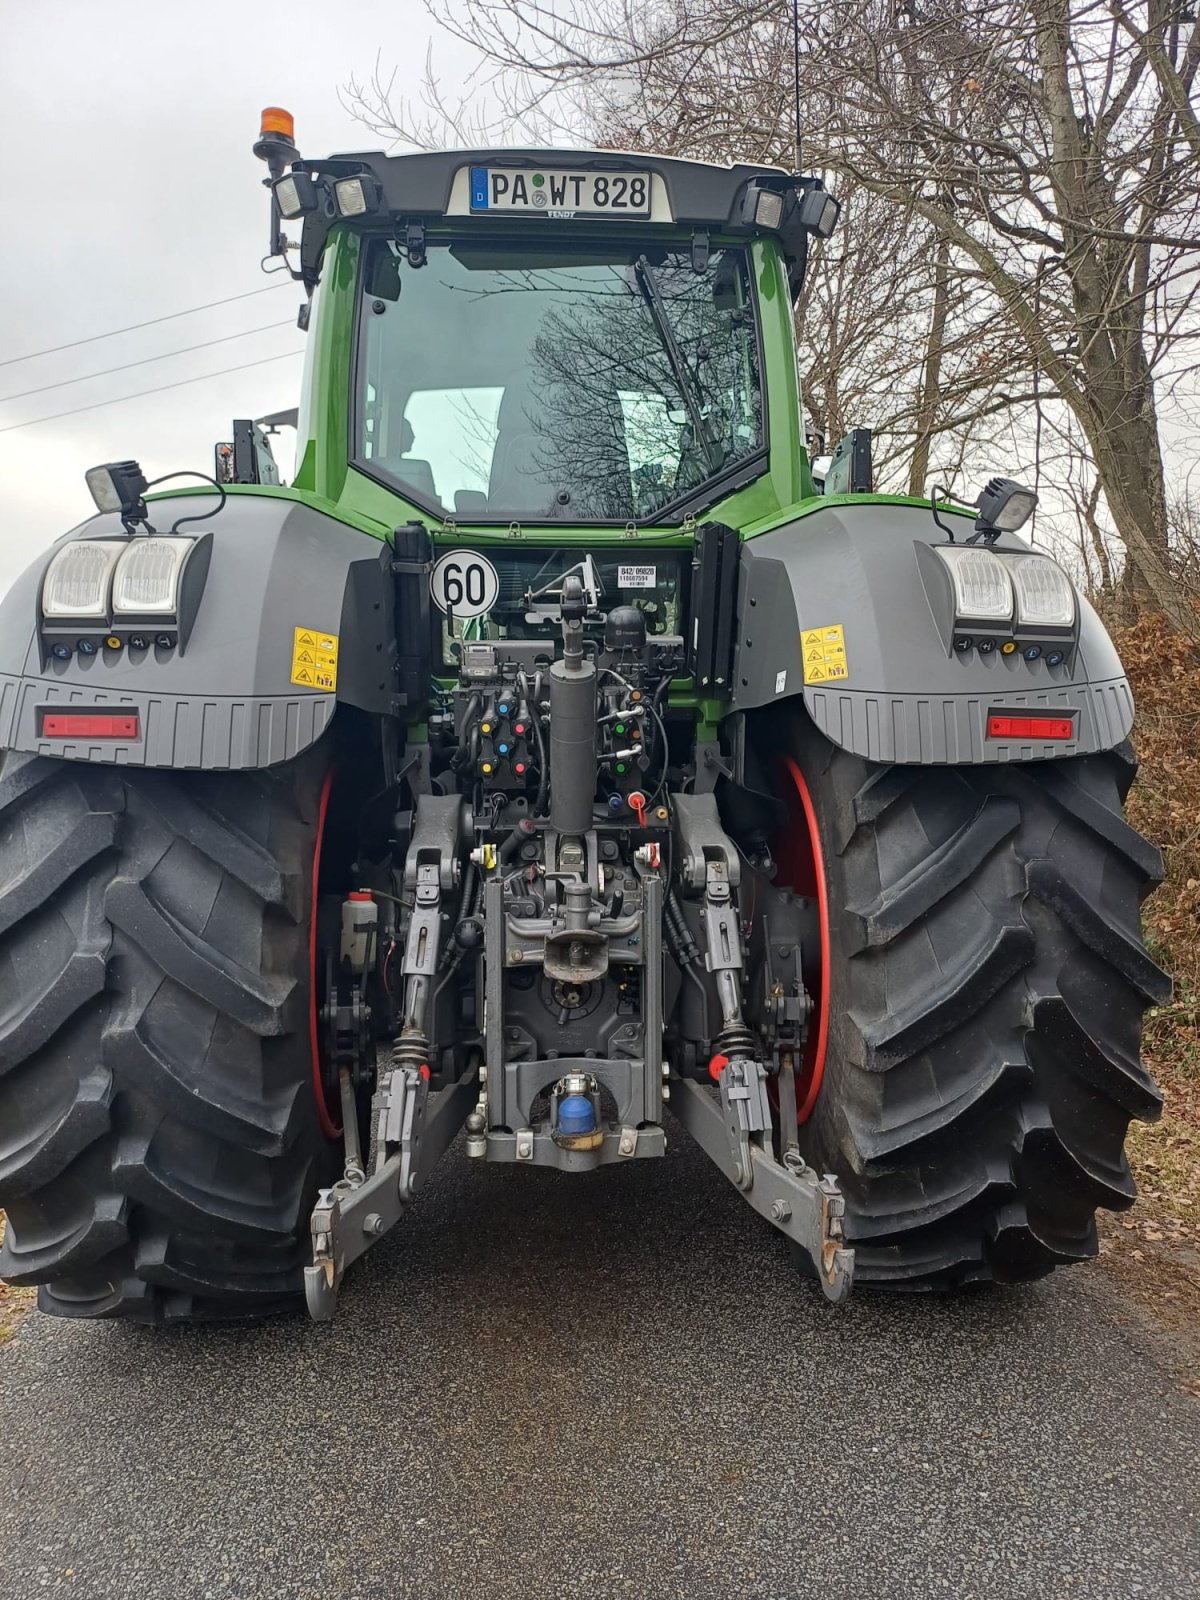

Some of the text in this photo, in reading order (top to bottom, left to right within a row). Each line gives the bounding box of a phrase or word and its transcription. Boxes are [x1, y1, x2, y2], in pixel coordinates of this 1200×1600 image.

[476, 193, 484, 202] D
[491, 173, 646, 208] PA WT 828
[443, 563, 486, 606] 60
